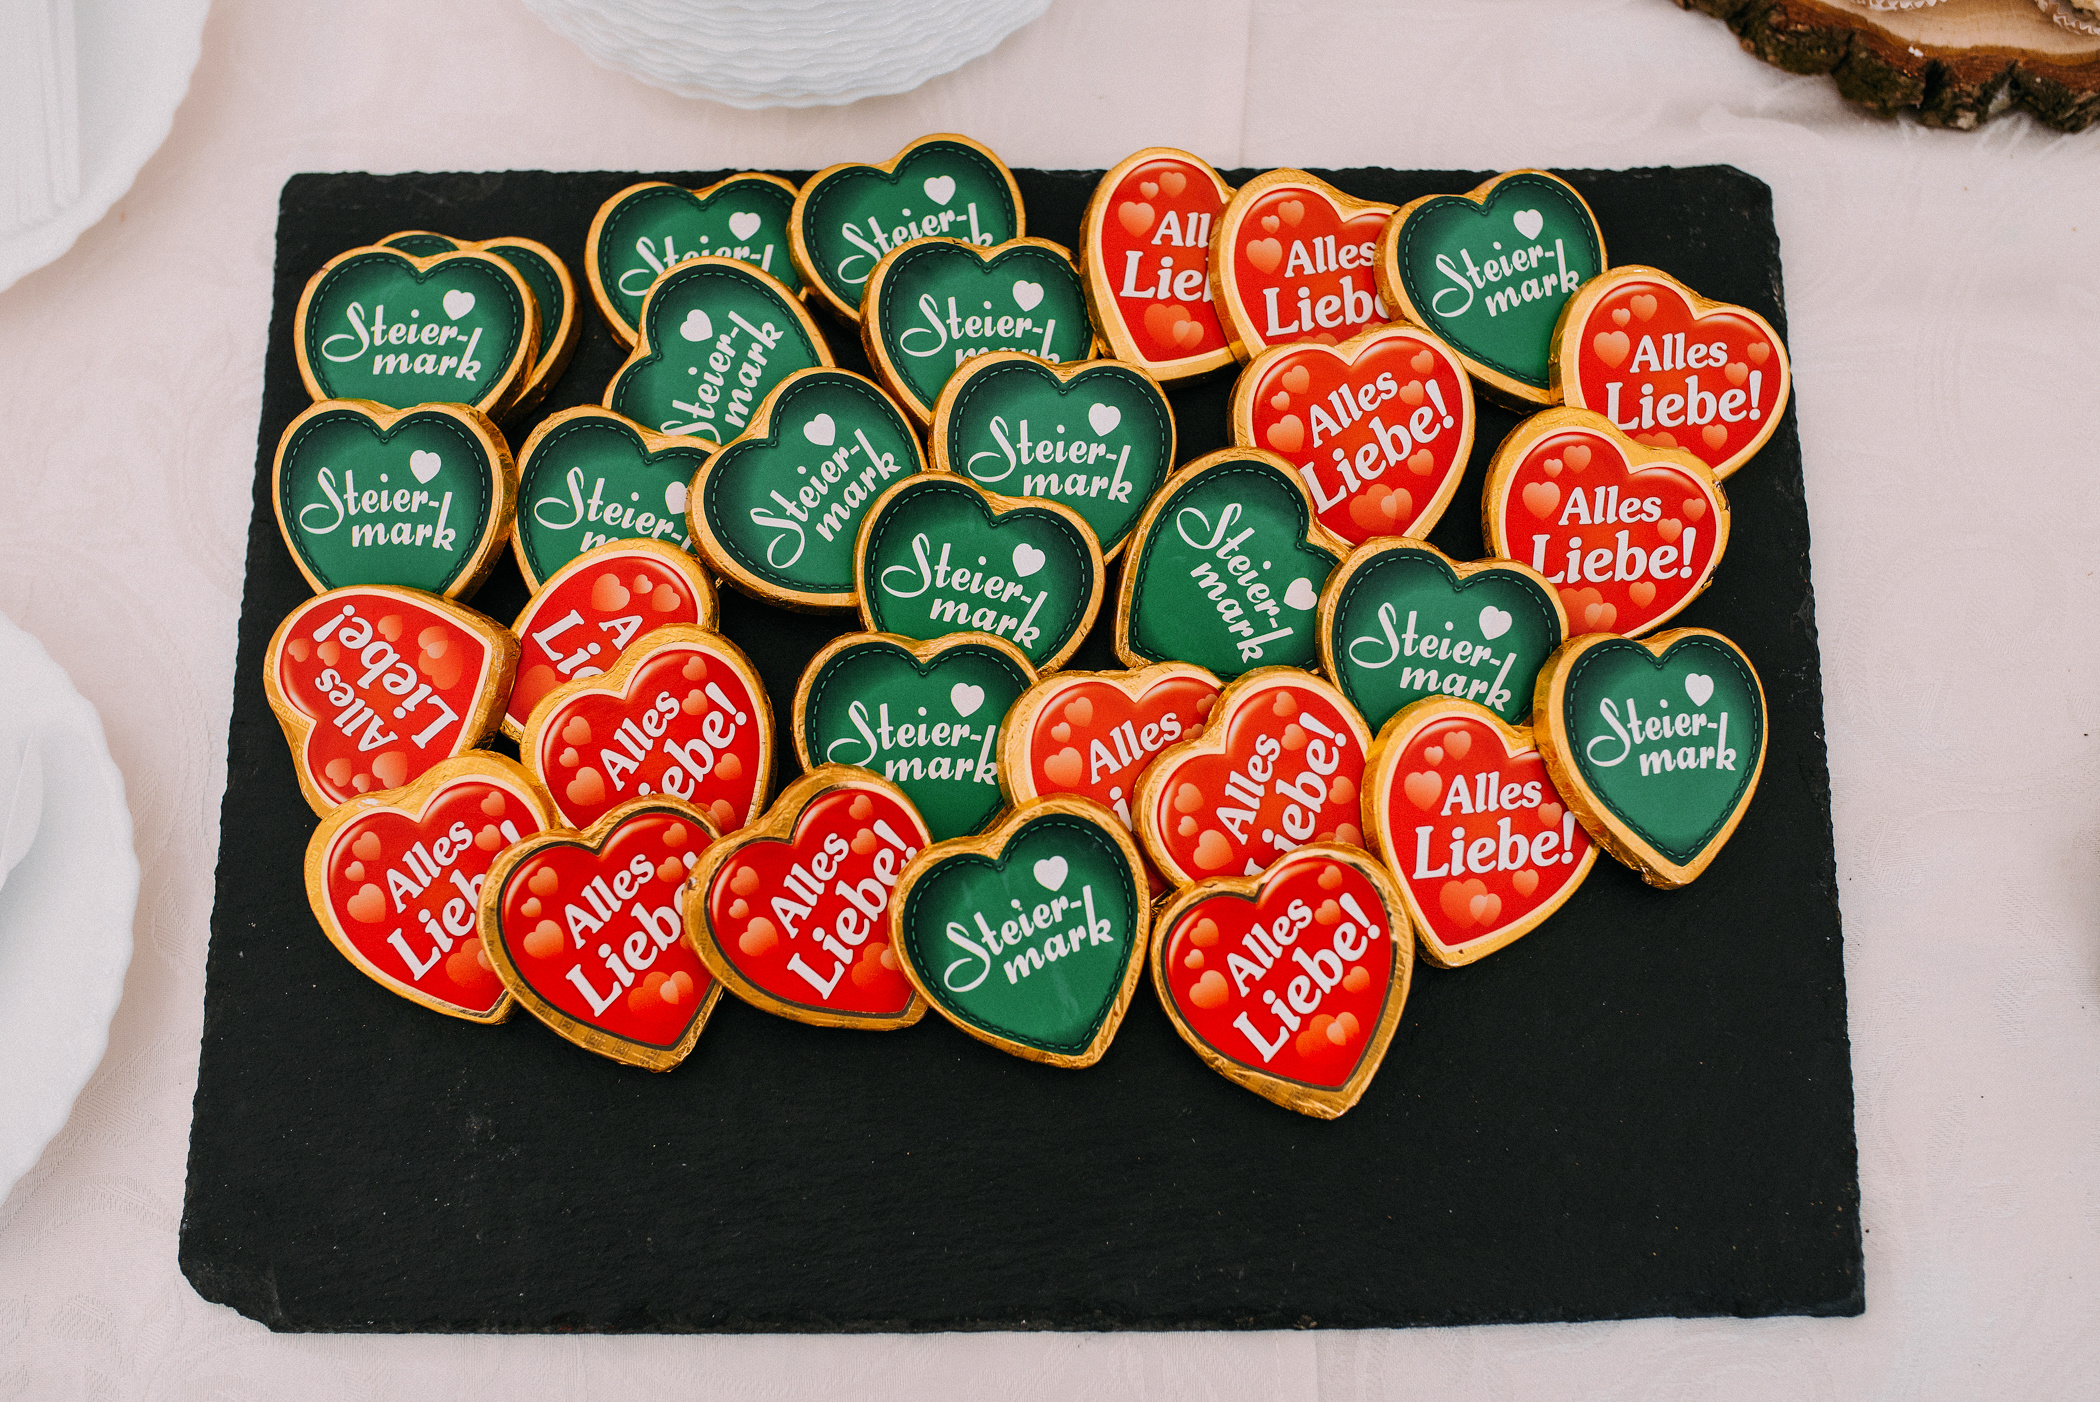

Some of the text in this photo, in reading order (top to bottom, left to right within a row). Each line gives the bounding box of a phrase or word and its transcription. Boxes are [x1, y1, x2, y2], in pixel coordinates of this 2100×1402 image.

[1151, 211, 1211, 248] All
[1284, 235, 1376, 278] Alles
[1262, 275, 1389, 337] Lieb
[1432, 241, 1556, 318] Steier-
[1484, 239, 1580, 317] mark
[321, 302, 468, 362] Steier-
[372, 327, 482, 381] mark
[900, 294, 1043, 358] Steier-
[1629, 333, 1728, 374] Alles
[659, 327, 740, 445] Steier-
[724, 310, 785, 428] mark
[1605, 371, 1762, 431] Liebe!
[1310, 371, 1398, 448] Alles
[967, 416, 1117, 483] Steier-
[1023, 445, 1133, 504] mark
[1299, 379, 1454, 515] Liebe!
[299, 467, 440, 535] Steier-
[351, 492, 457, 552] mark
[534, 467, 683, 542] Steier-
[749, 442, 861, 569] Steier-
[815, 428, 902, 543] mark
[1558, 485, 1662, 526] Alles
[880, 533, 1033, 605] Steier-
[1176, 503, 1281, 632] Steier-
[1531, 527, 1697, 584] Liebe!
[929, 591, 1049, 650] mark
[1189, 562, 1294, 664] mark
[1349, 602, 1501, 668] Steier-
[312, 604, 460, 750] Liebe!
[314, 668, 399, 753] Alles
[1399, 653, 1518, 712] mark
[600, 691, 680, 792] Alles
[826, 701, 982, 768] Steier-
[886, 725, 998, 786] mark
[1090, 712, 1182, 785] Alles
[1587, 698, 1718, 768] Steier-
[1638, 712, 1737, 777] mark
[1215, 733, 1281, 846] Alles
[1243, 712, 1347, 876] iebe!
[1442, 771, 1542, 816] Alles
[386, 821, 474, 914] Alles
[1412, 812, 1576, 880] Liebe!
[564, 853, 655, 949] Alles
[771, 833, 849, 940] Alles
[786, 819, 918, 1000] Liebe!
[943, 895, 1083, 993] Steier-
[1003, 884, 1114, 984] mark
[1227, 898, 1313, 998] Alles
[1232, 892, 1381, 1063] Liebe!
